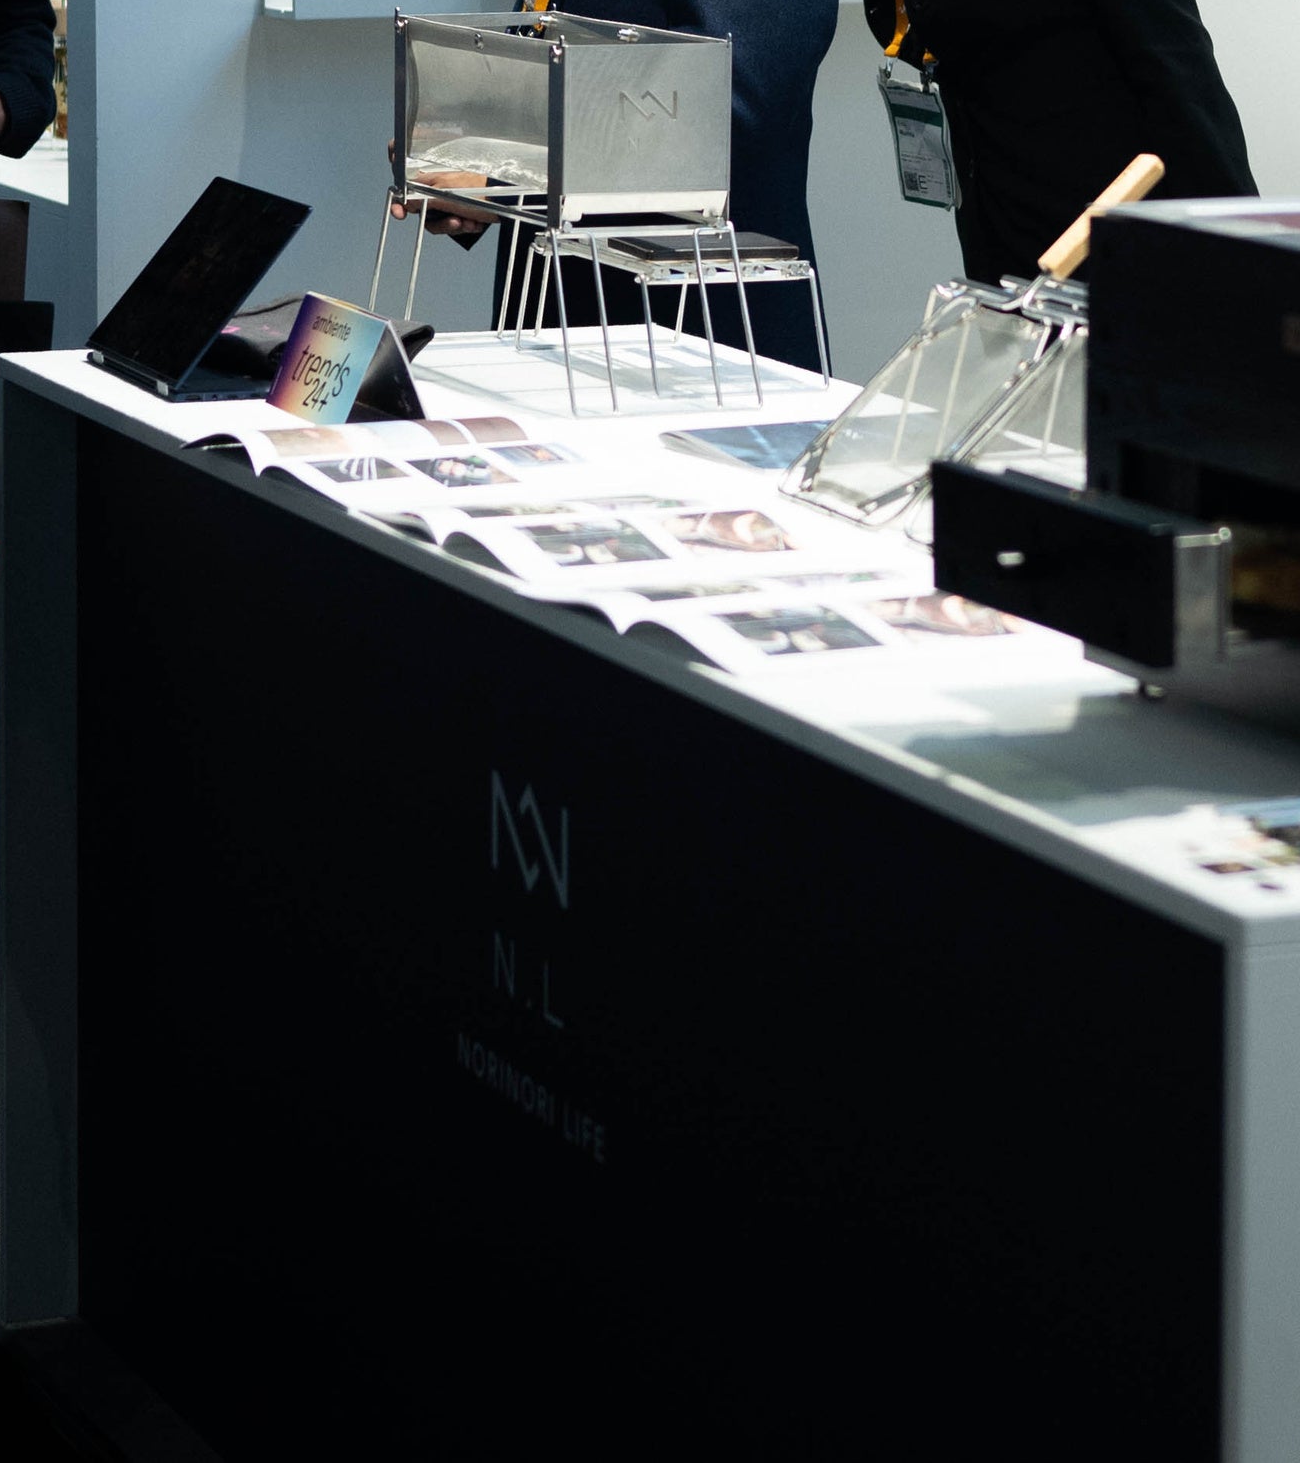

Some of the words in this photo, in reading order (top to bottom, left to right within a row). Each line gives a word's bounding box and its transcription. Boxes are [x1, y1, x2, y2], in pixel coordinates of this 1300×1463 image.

[312, 313, 351, 342] ambiente
[292, 344, 351, 398] trends
[302, 378, 330, 412] 24+
[457, 1033, 555, 1128] NORINORI
[563, 1099, 605, 1165] LIFE
